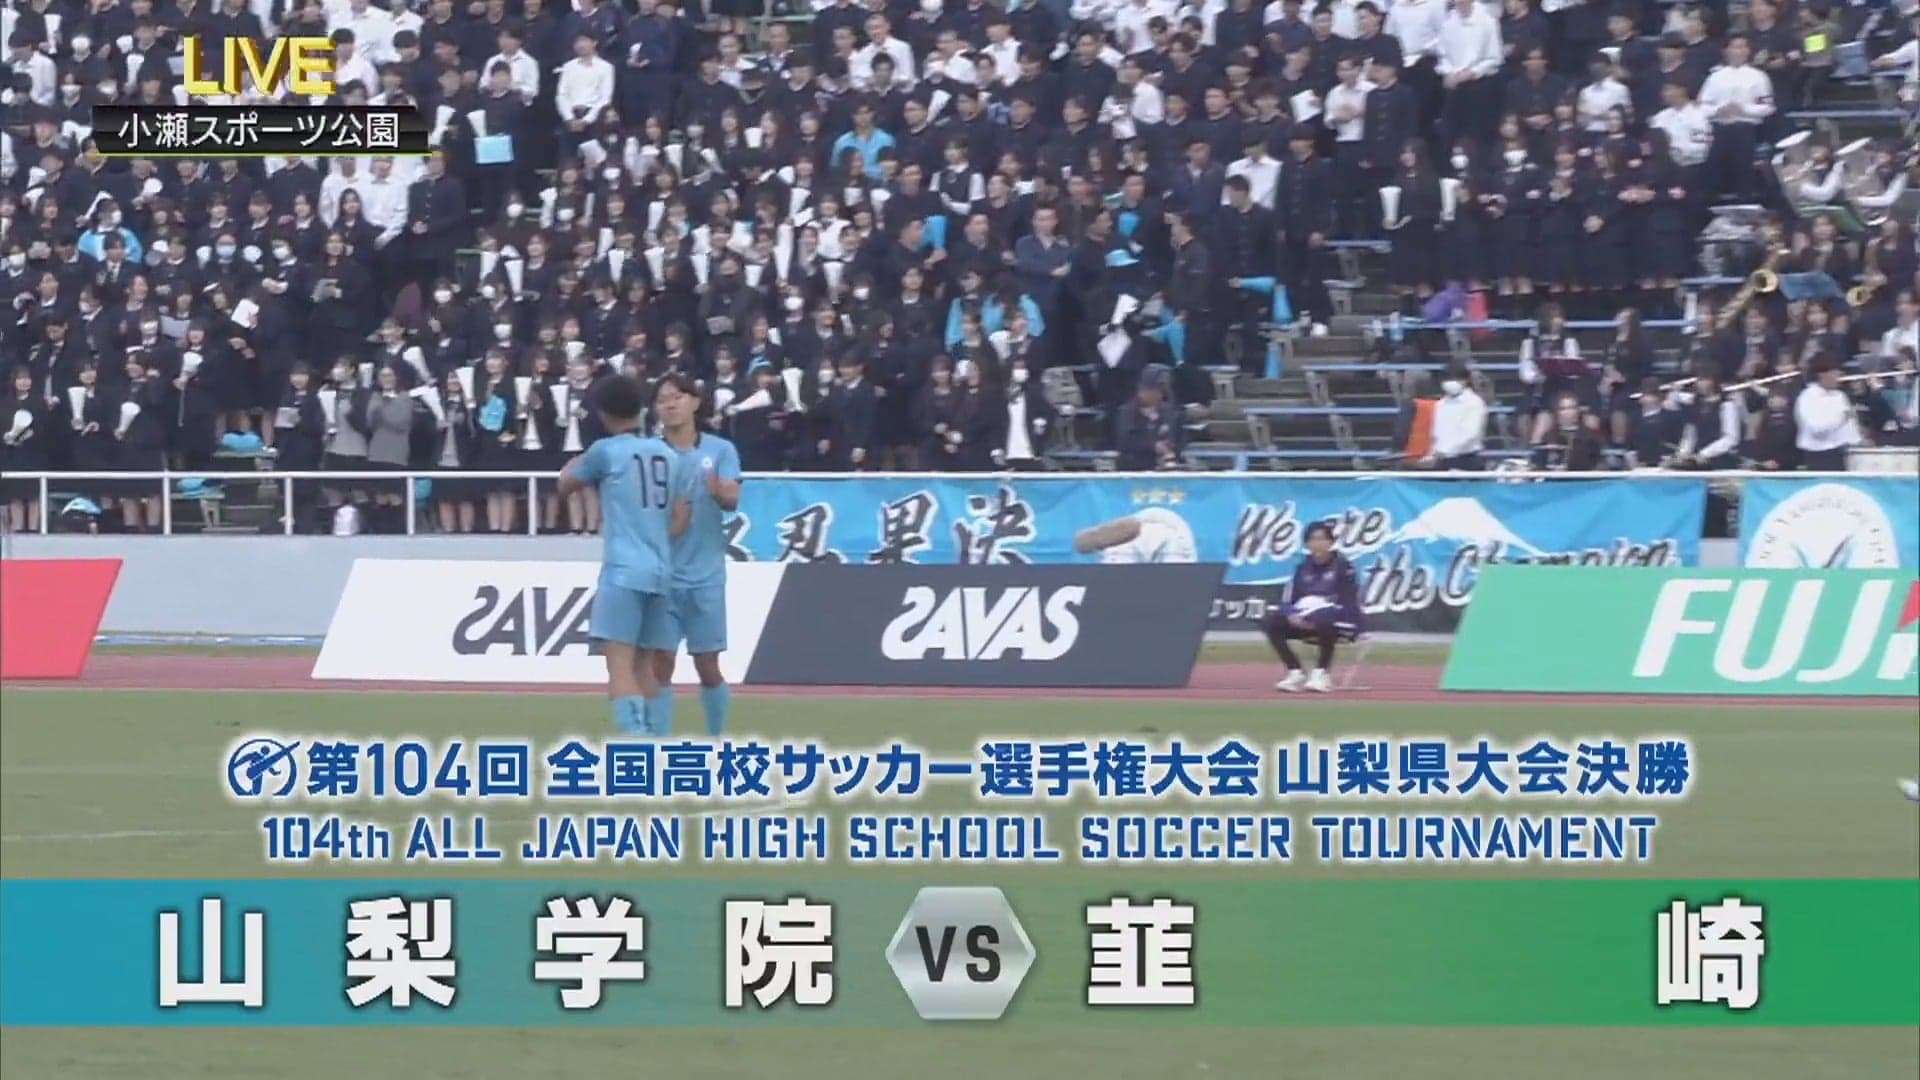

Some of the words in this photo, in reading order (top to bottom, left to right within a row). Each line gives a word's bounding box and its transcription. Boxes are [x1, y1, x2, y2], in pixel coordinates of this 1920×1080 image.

[631, 452, 671, 510] 19
[1231, 500, 1299, 565] We
[1359, 548, 1436, 613] the
[881, 585, 1086, 660] SAVAS
